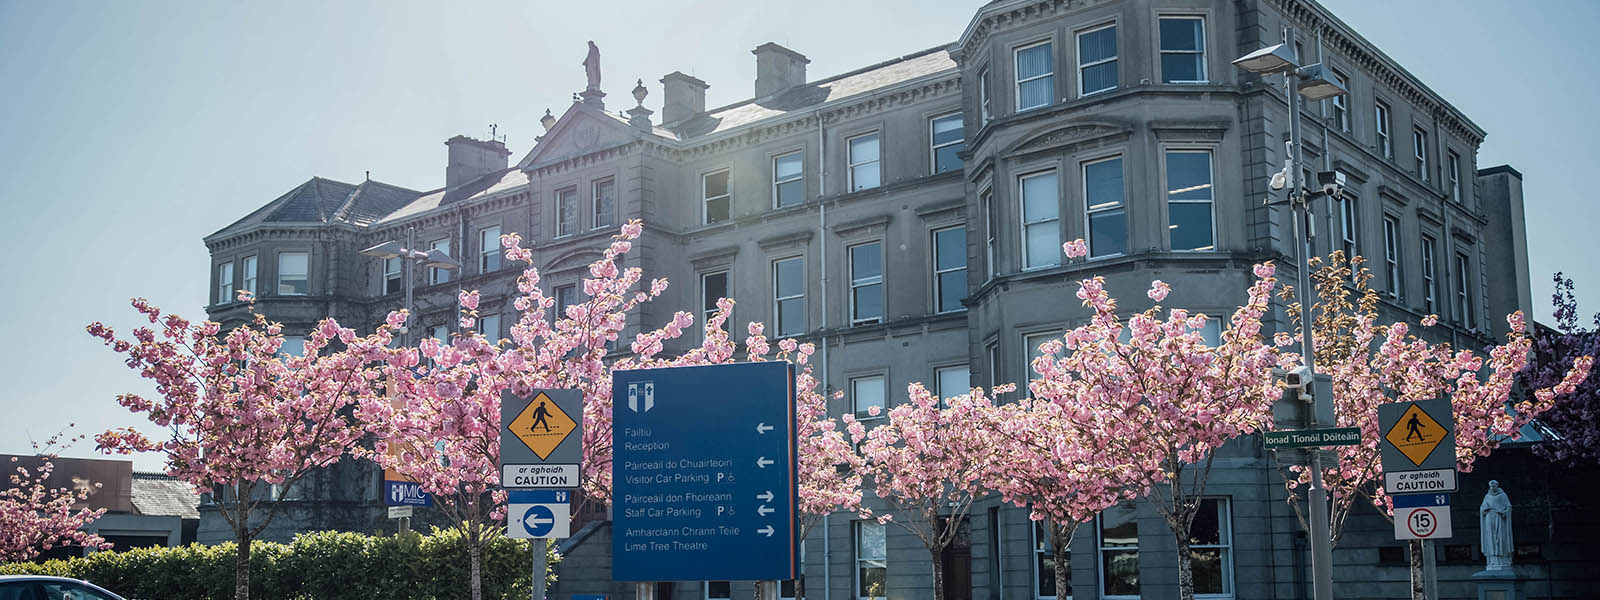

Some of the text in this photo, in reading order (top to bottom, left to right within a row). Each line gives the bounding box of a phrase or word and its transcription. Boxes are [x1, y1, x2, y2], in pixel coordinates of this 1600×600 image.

[1265, 431, 1359, 444] Ionad Tionóil Dóiteáin
[625, 441, 670, 451] Reception
[530, 466, 564, 474] aghaidh
[666, 460, 677, 469] do
[514, 476, 567, 485] CAUTION
[625, 472, 725, 484] Visitor Car Parking P
[1410, 471, 1440, 480] aghaidh
[1396, 480, 1445, 490] CAUTION
[404, 484, 426, 499] MIC
[666, 493, 682, 503] don
[685, 492, 732, 502] Fhoireann
[625, 505, 725, 518] Staff Car Parking P
[1413, 513, 1430, 528] 15
[625, 525, 740, 537] Amharclann Chrann Teile
[625, 541, 708, 552] Lime Tree Theatre
